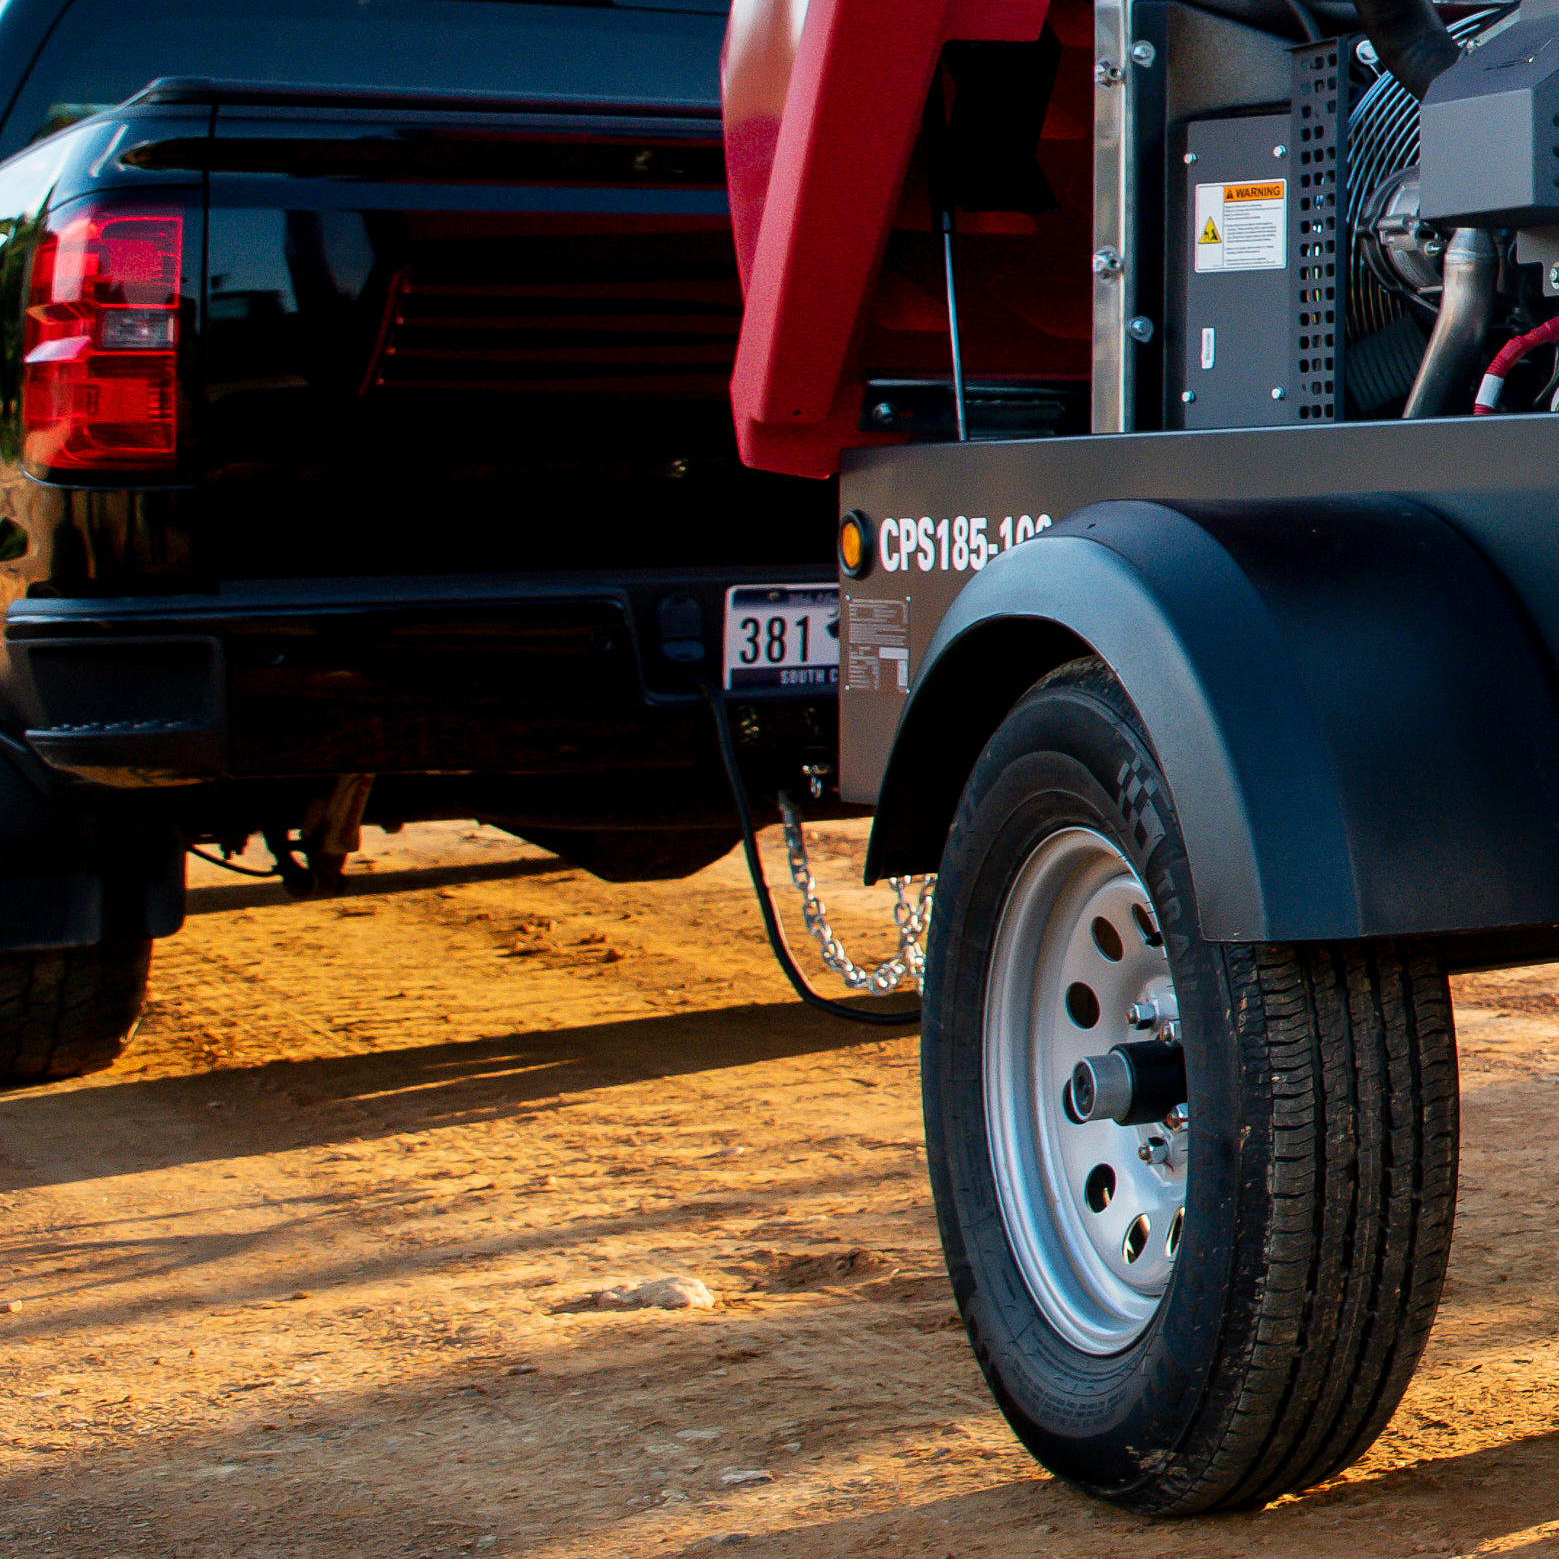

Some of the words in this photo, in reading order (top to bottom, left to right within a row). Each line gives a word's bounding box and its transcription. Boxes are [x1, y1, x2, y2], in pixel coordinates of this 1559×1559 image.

[1235, 185, 1280, 198] WARNING
[739, 615, 811, 664] 381
[780, 669, 825, 685] SOUTH
